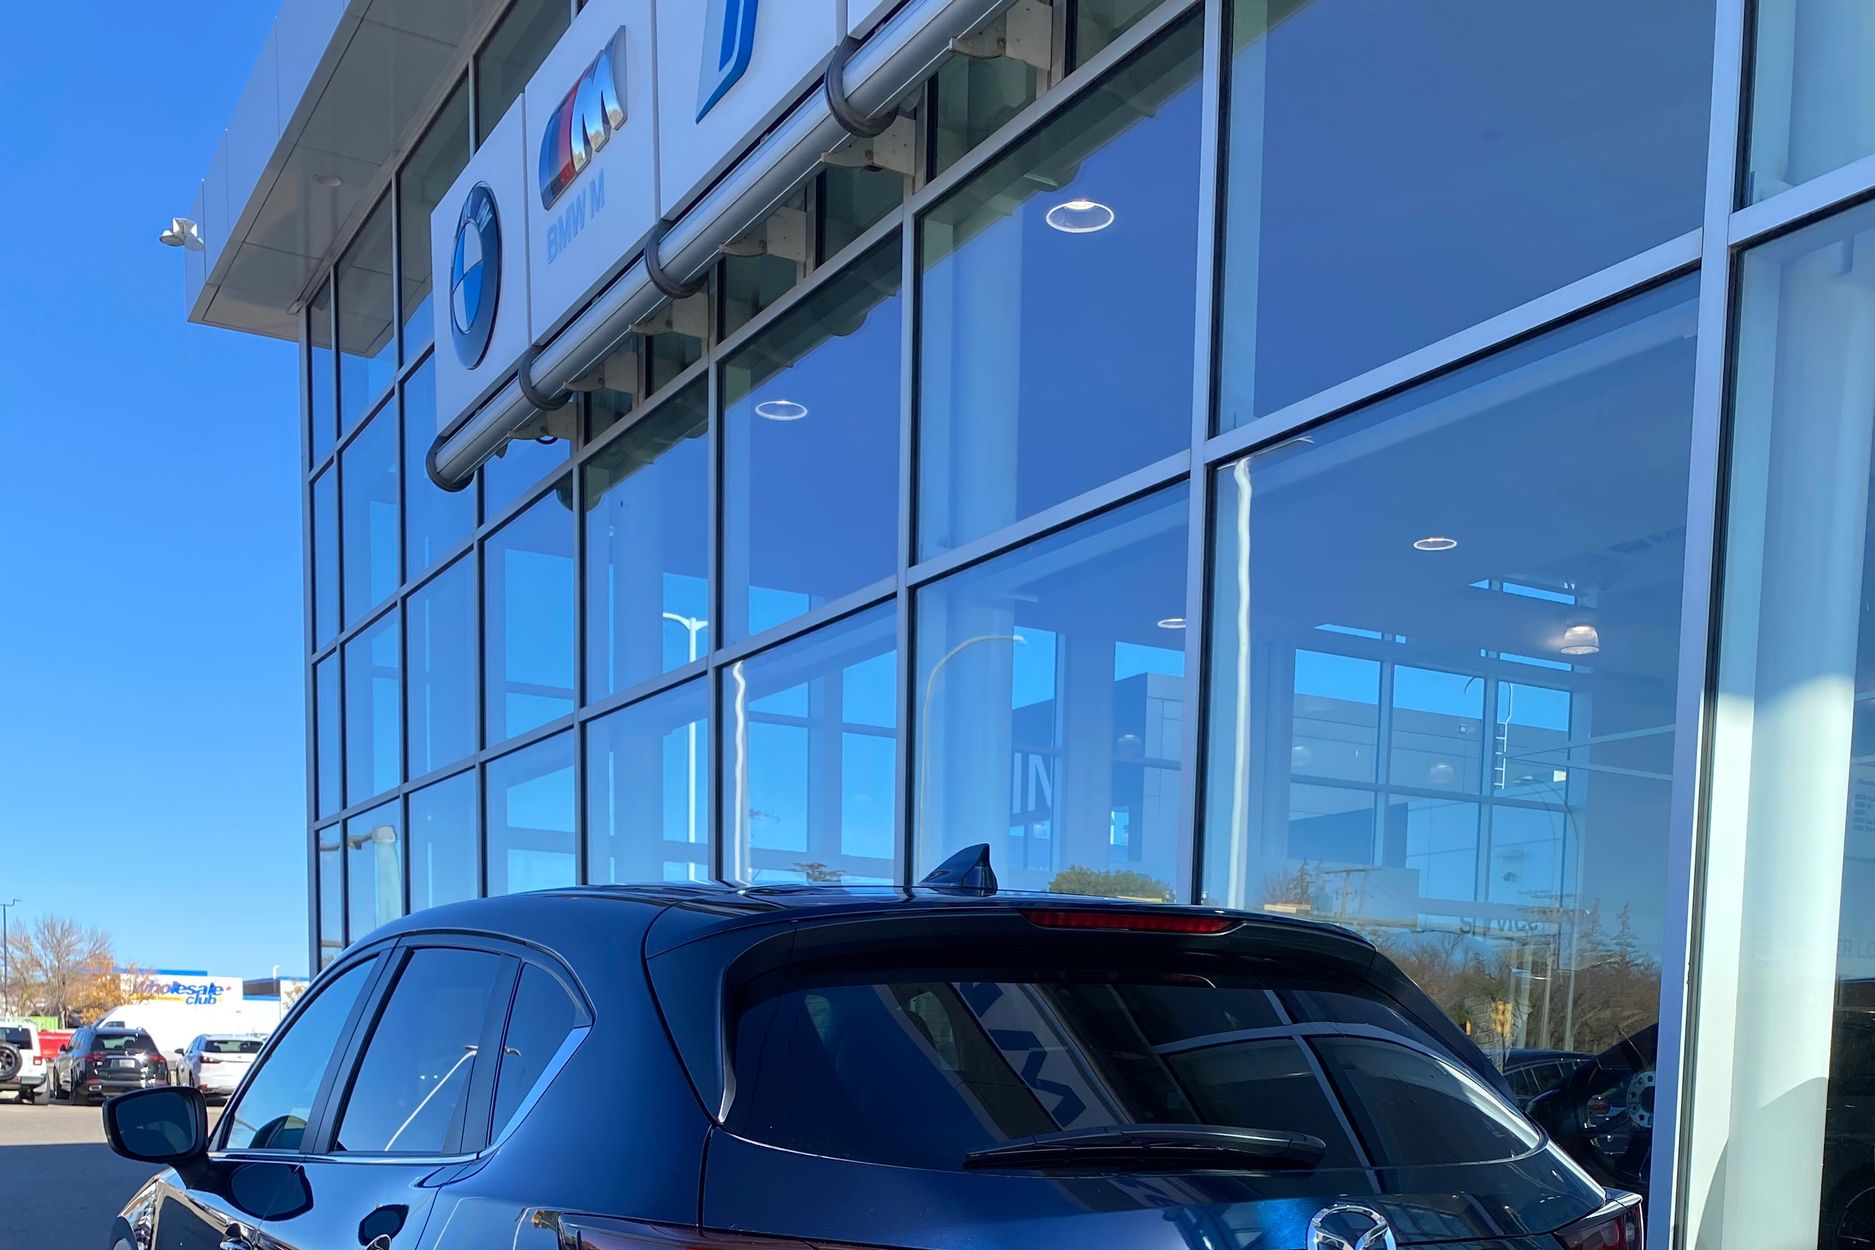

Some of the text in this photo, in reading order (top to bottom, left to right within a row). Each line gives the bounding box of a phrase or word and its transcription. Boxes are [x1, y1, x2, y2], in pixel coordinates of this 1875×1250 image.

[547, 168, 606, 265] BMW M
[185, 993, 217, 1005] club
